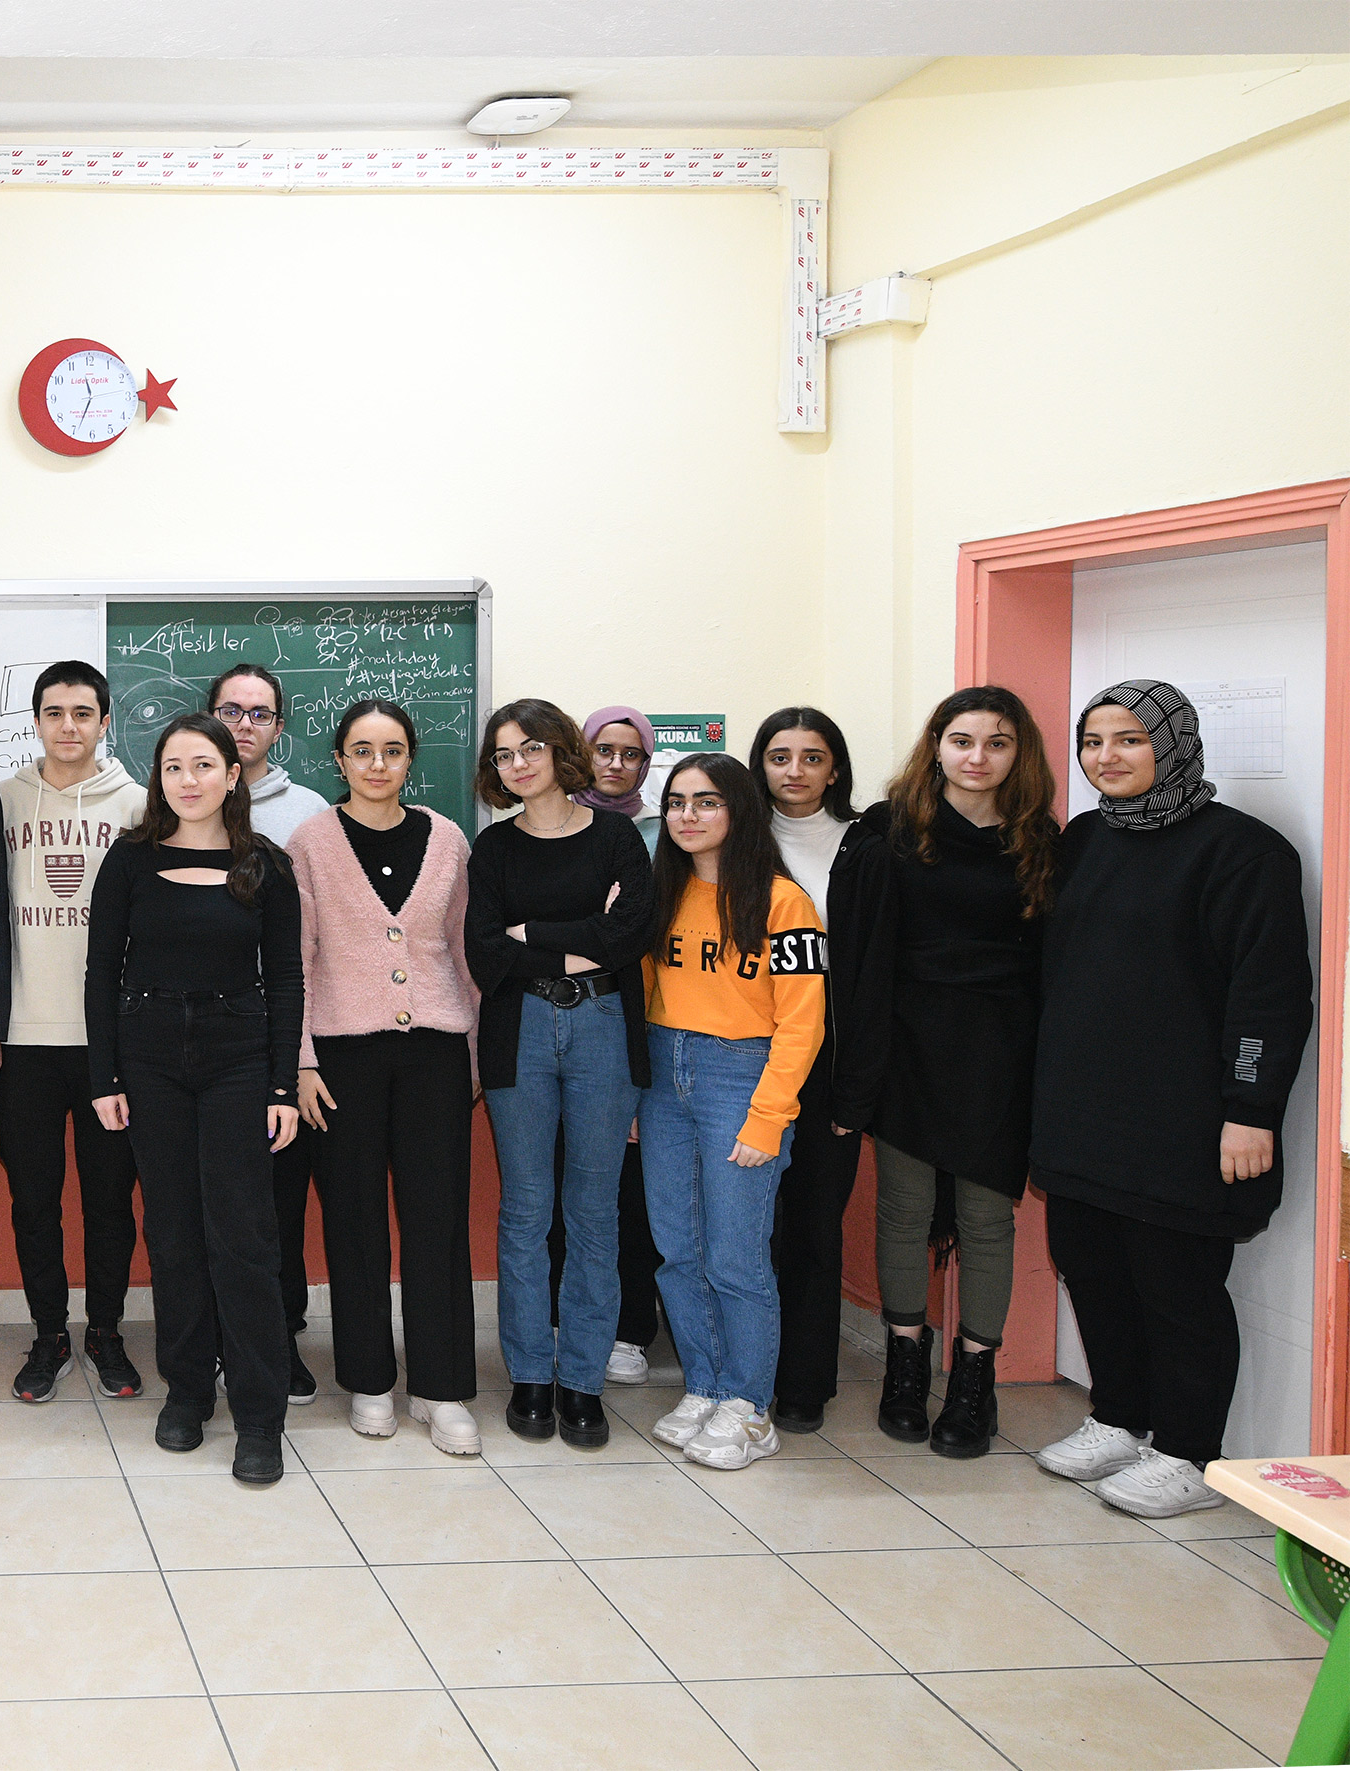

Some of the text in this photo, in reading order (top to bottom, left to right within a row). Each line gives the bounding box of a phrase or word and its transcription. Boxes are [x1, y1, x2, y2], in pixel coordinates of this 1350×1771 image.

[68, 361, 75, 371] 11
[85, 355, 95, 367] 12
[106, 360, 110, 370] 1
[54, 375, 64, 386] 10
[90, 377, 109, 385] Optik
[118, 373, 125, 384] 2
[50, 394, 57, 404] 9
[124, 391, 132, 401] 3
[57, 412, 64, 423] 8
[120, 411, 126, 420] 4
[71, 424, 77, 435] 7
[89, 429, 96, 439] 6
[107, 424, 114, 434] 5
[658, 731, 702, 743] KURAL
